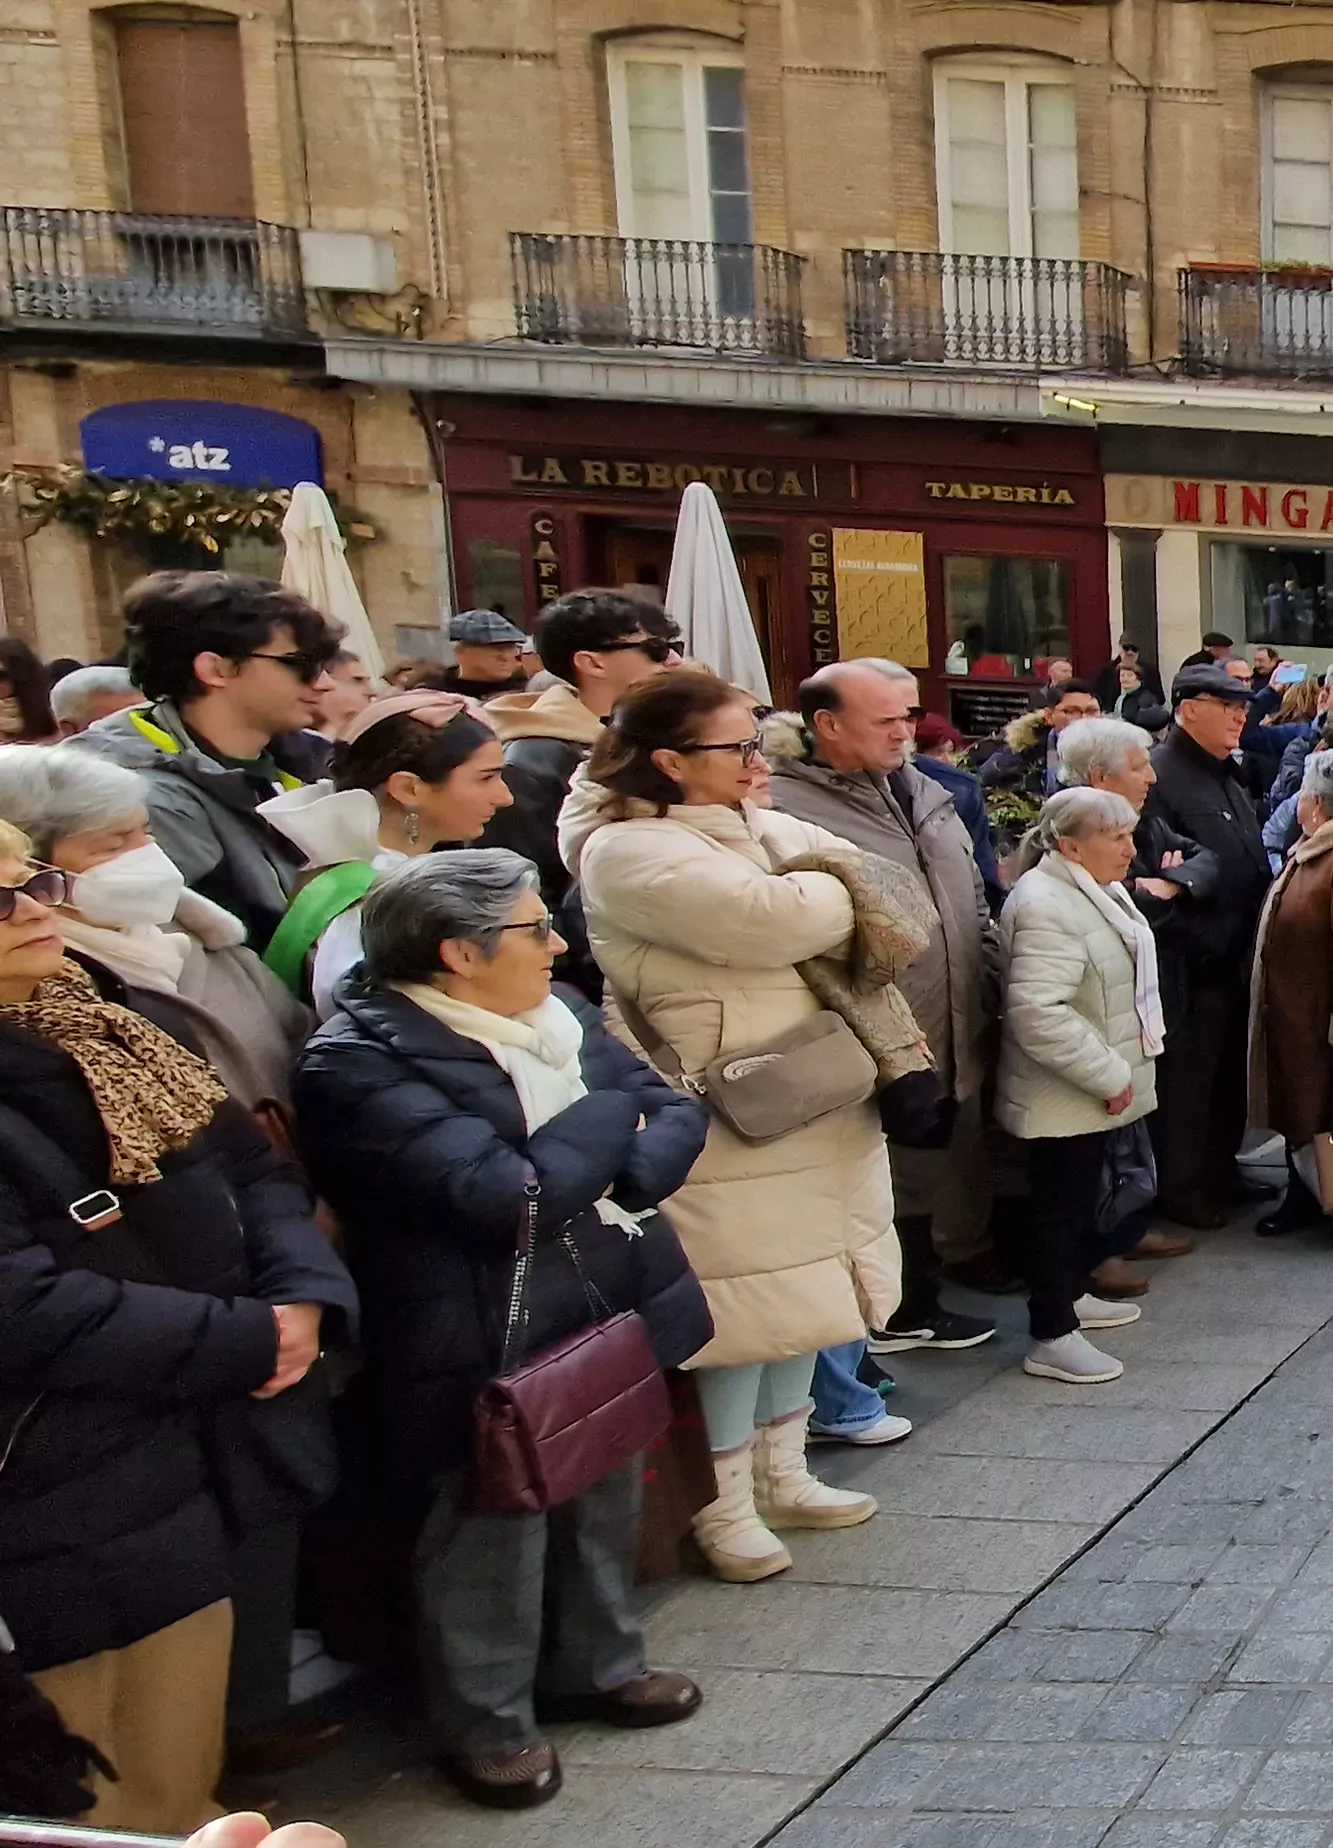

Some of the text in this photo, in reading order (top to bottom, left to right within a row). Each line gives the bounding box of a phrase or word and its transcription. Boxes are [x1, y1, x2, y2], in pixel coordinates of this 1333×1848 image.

[508, 454, 807, 497] LA REBOTICA
[925, 480, 1076, 505] TAPERÍA
[535, 519, 560, 600] CAFE
